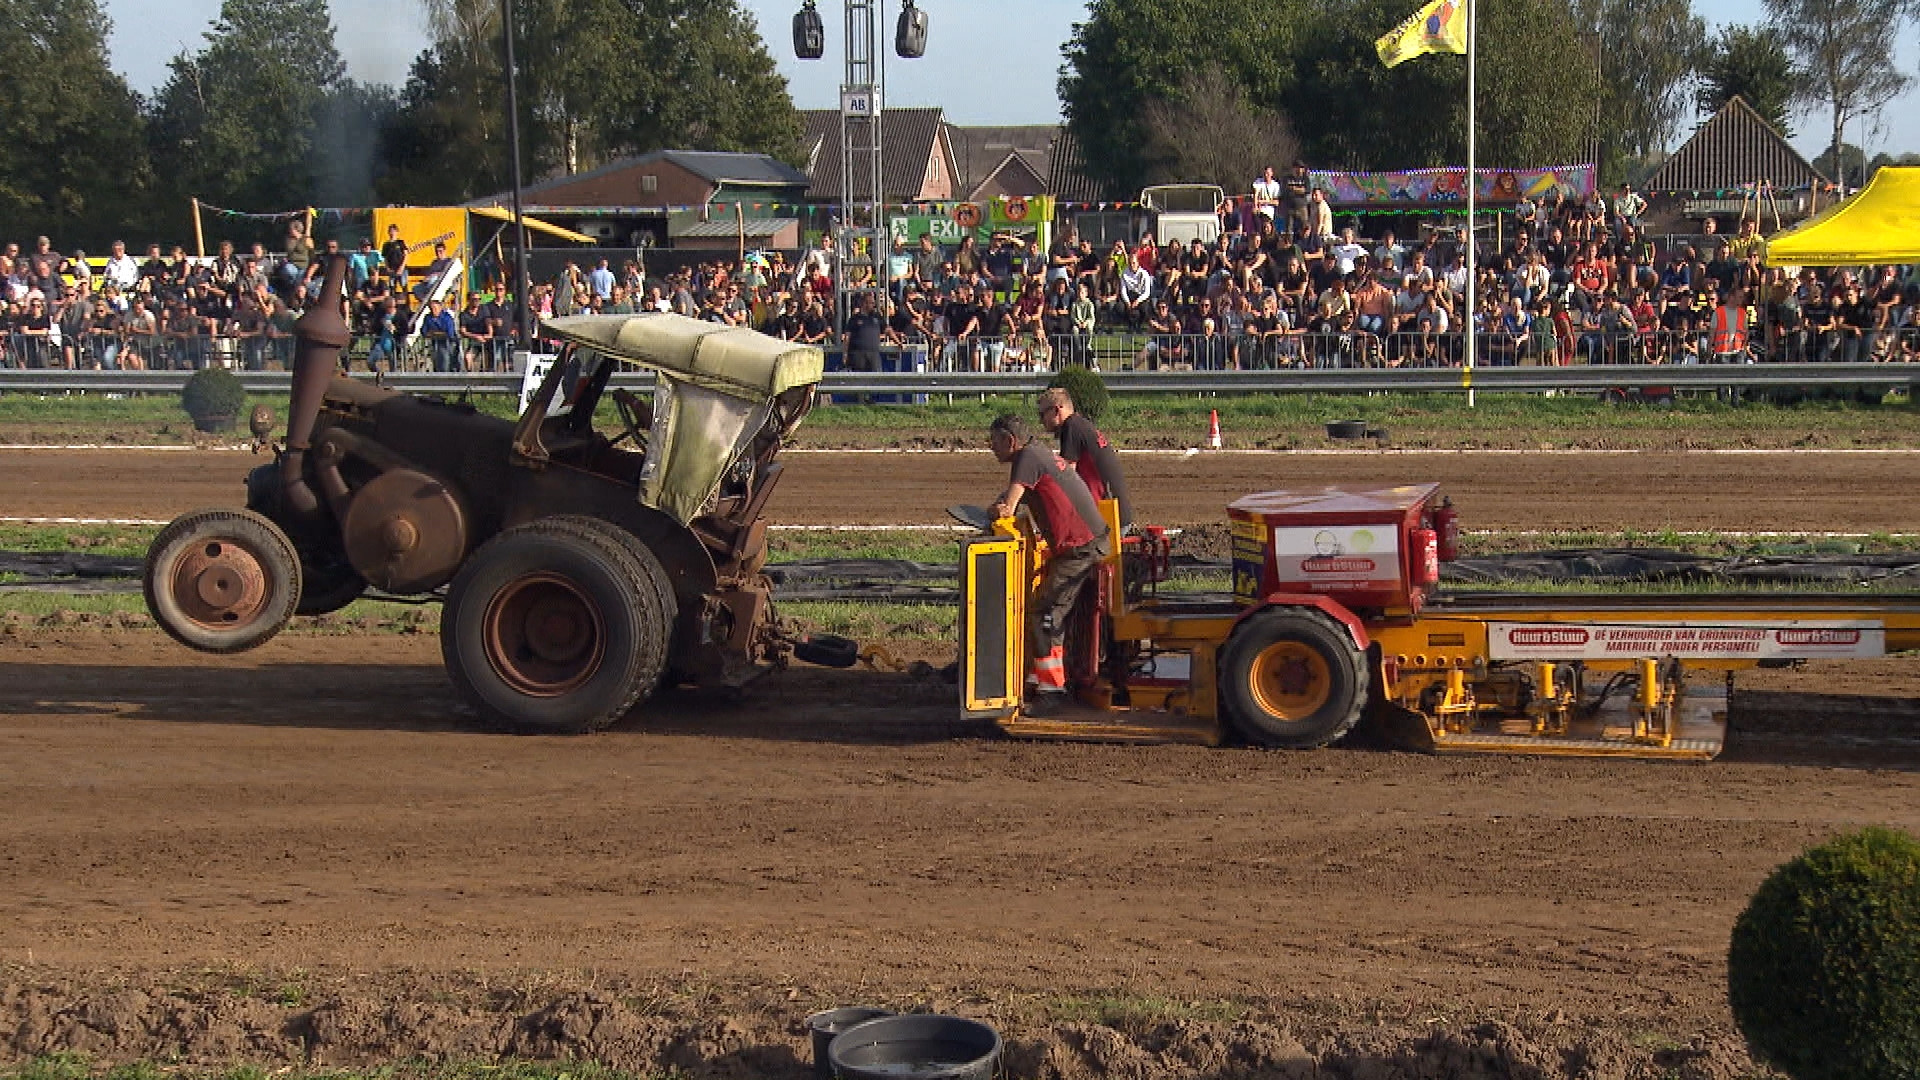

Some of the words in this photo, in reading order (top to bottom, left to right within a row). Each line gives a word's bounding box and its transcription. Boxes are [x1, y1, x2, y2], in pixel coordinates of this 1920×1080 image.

[851, 98, 865, 110] AB
[1675, 629, 1696, 641] VAN
[1660, 641, 1699, 652] ZONDER
